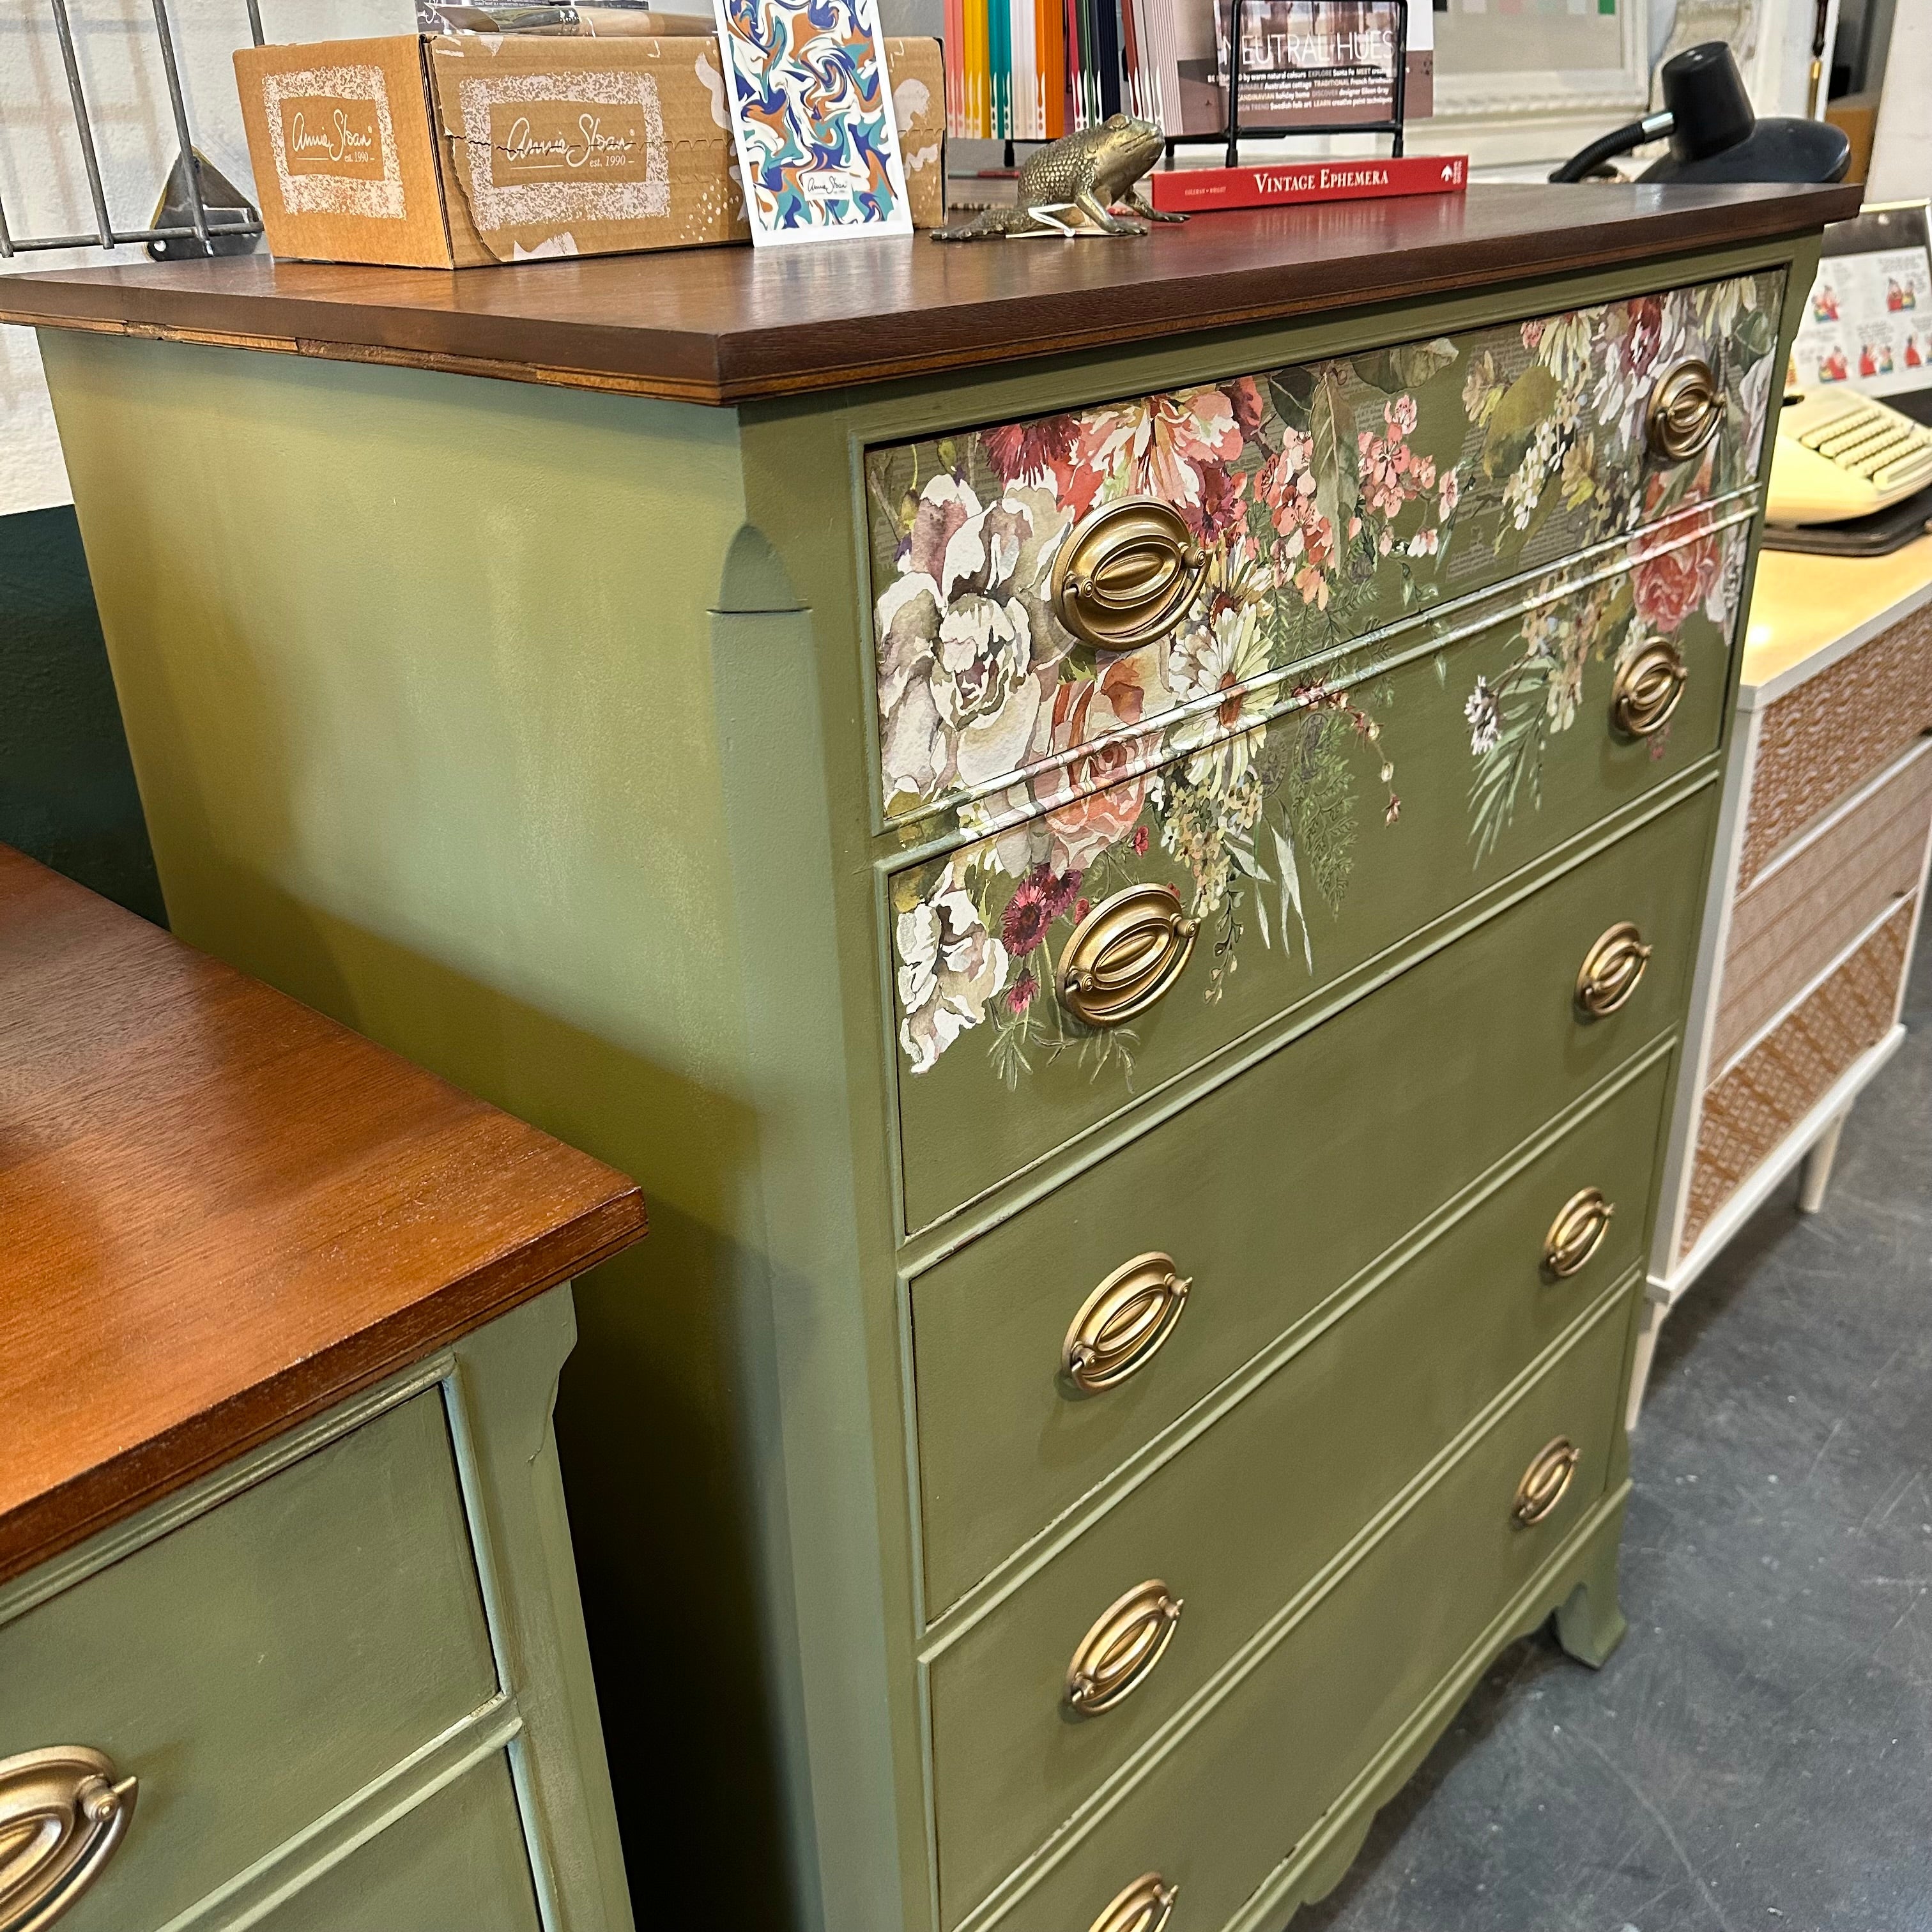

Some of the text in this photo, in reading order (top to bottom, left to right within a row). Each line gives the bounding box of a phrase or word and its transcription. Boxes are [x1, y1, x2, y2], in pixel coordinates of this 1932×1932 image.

[1223, 30, 1394, 65] NEUTRAL HUES
[1267, 72, 1286, 80] natural
[293, 109, 372, 162] Annie Sloan
[507, 112, 633, 167] Annie Sloan
[355, 151, 369, 162] 1990
[589, 155, 626, 167] est. 1990
[1254, 168, 1389, 194] VINTAGE EPHEMERA
